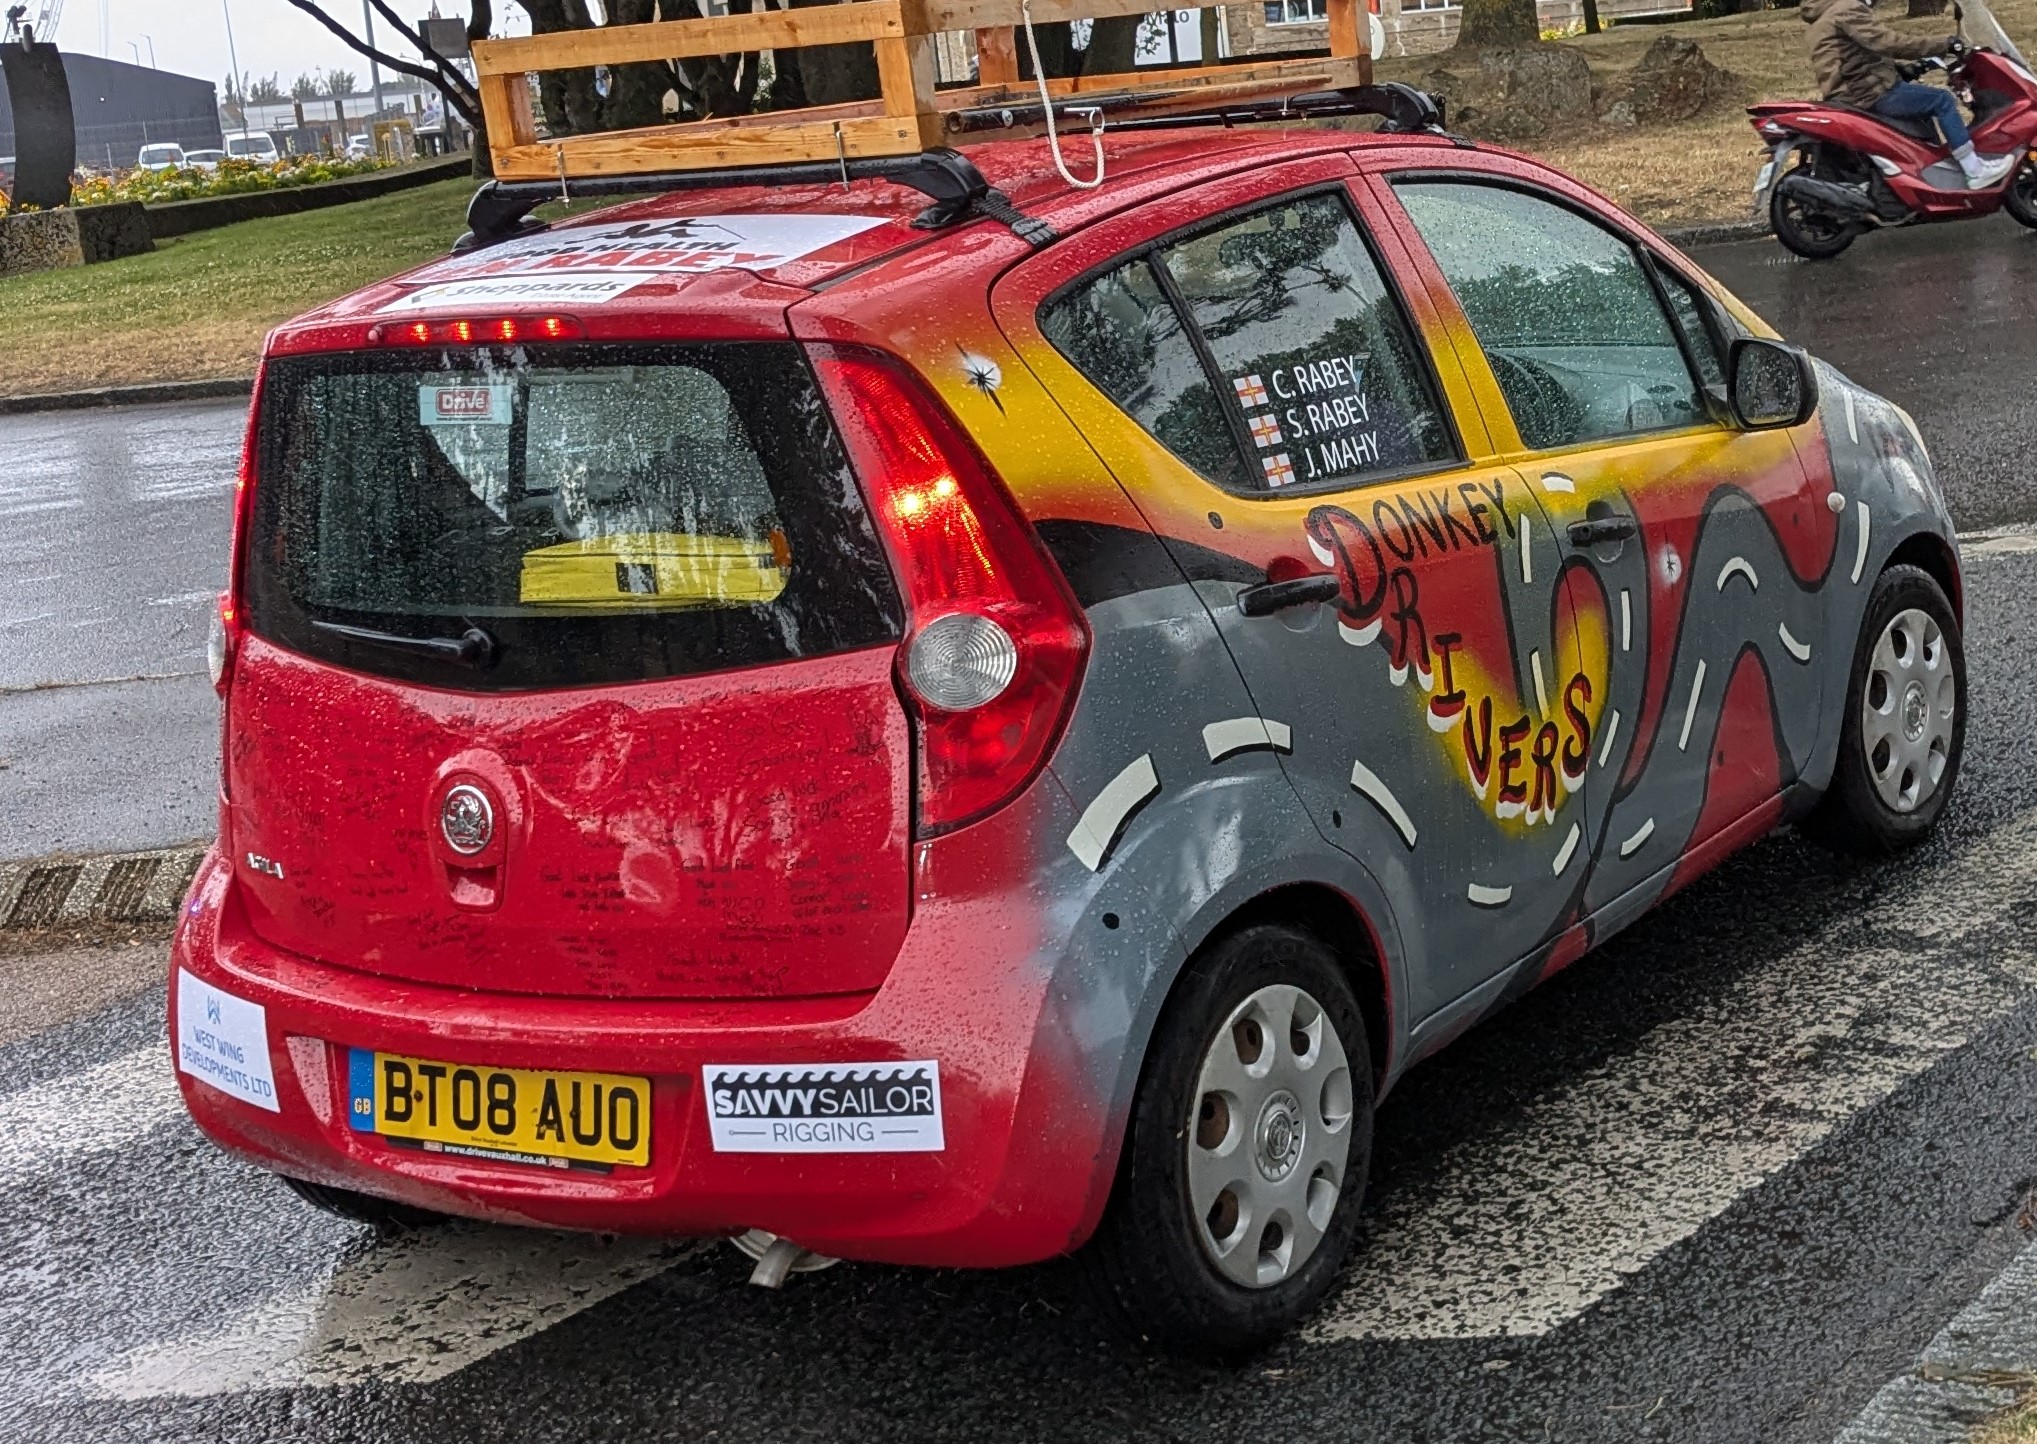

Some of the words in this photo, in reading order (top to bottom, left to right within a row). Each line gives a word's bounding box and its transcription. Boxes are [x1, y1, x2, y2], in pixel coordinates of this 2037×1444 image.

[525, 250, 786, 271] RABEY
[587, 241, 742, 253] HEALTH
[447, 281, 626, 297] Sheppards
[1272, 368, 1297, 399] C.
[1293, 354, 1358, 395] RABEY
[442, 391, 486, 411] Drive
[1286, 408, 1309, 439] S.
[1306, 392, 1370, 434] RABEY
[1305, 447, 1322, 478] J.
[1320, 430, 1380, 473] MAHY
[1306, 478, 1516, 620] DONKEY
[193, 1026, 215, 1050] WEST
[217, 1037, 244, 1064] WING
[182, 1043, 250, 1091] DEVELOPMENTS
[251, 1075, 272, 1098] LTD
[384, 1060, 517, 1136] BT08
[536, 1078, 640, 1151] AUO
[773, 1121, 875, 1143] RIGGING
